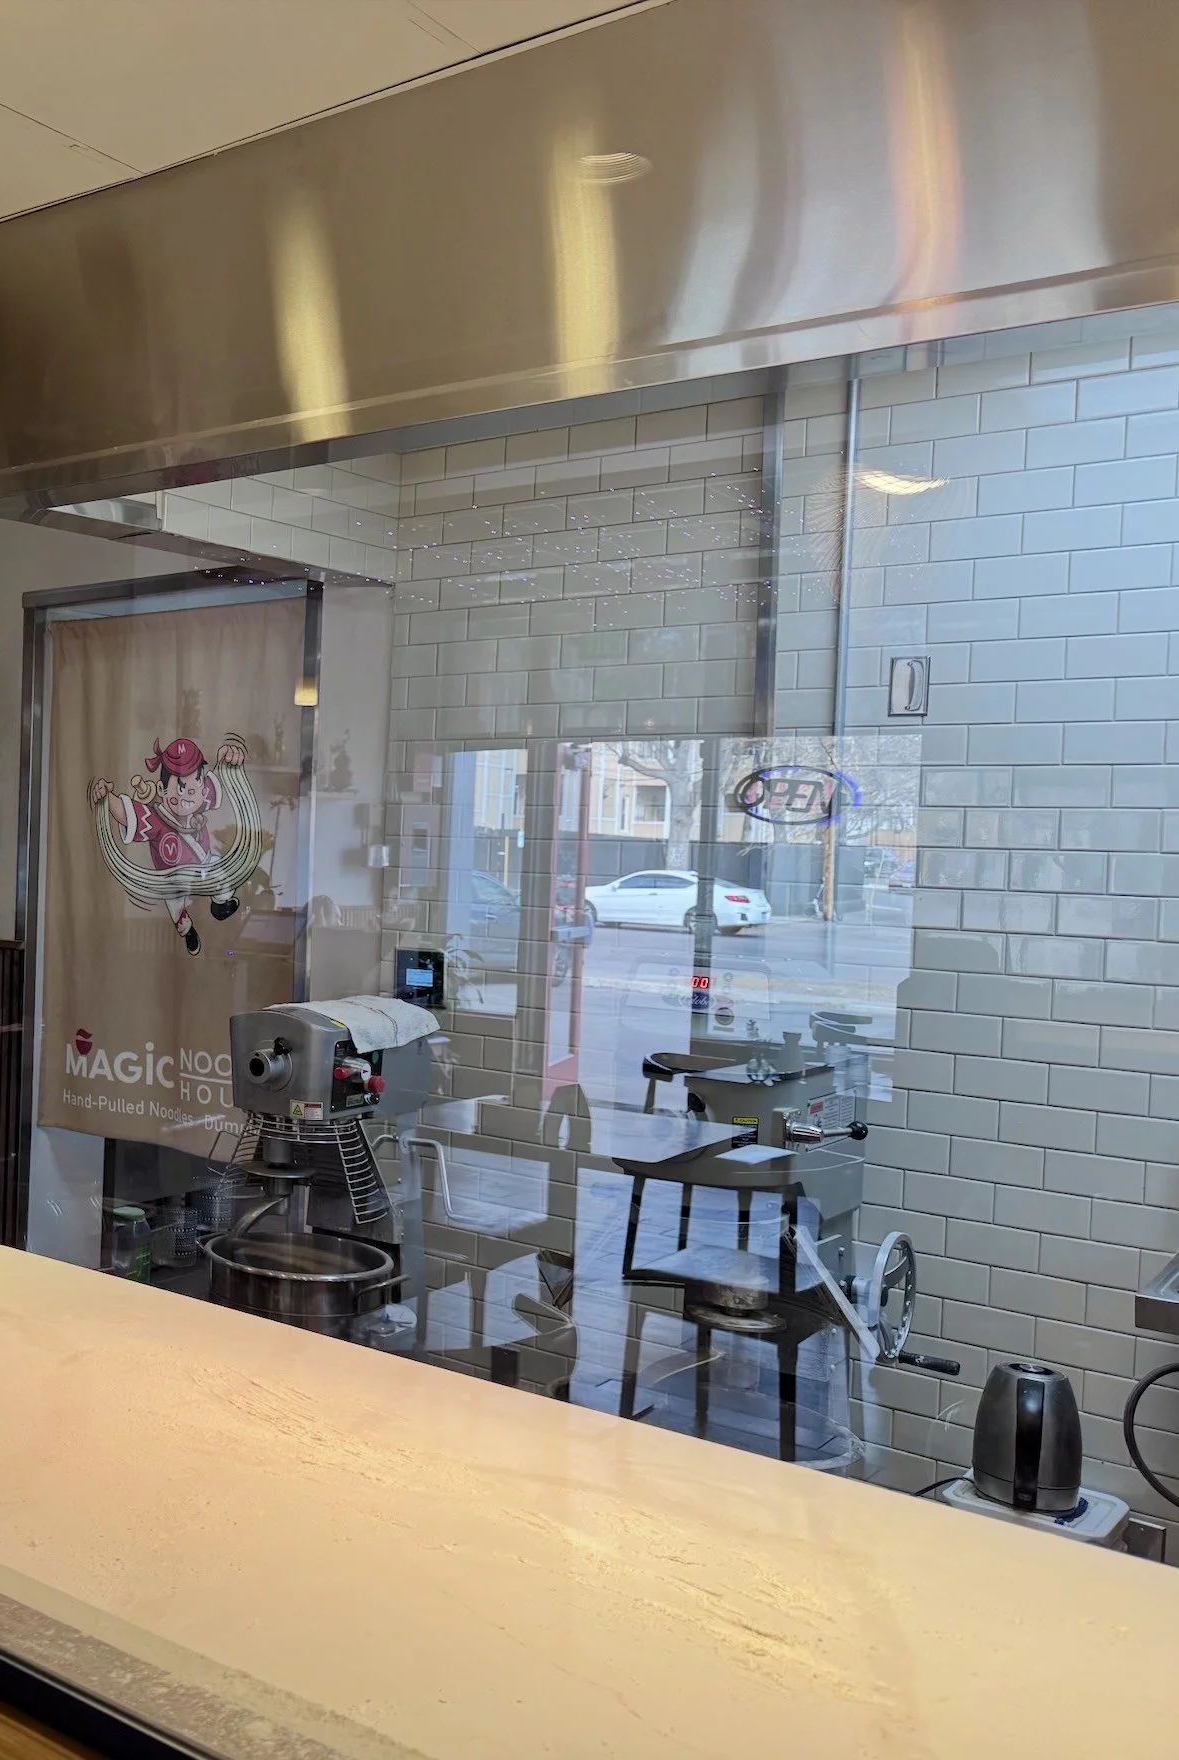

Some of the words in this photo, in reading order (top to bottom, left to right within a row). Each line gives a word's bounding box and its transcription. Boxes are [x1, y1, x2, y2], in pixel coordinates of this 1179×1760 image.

[177, 743, 186, 755] M
[740, 777, 833, 814] OPEN
[63, 1088, 144, 1115] Hand-Pulled
[149, 1101, 194, 1126] Noodles
[204, 1114, 245, 1137] Dum
